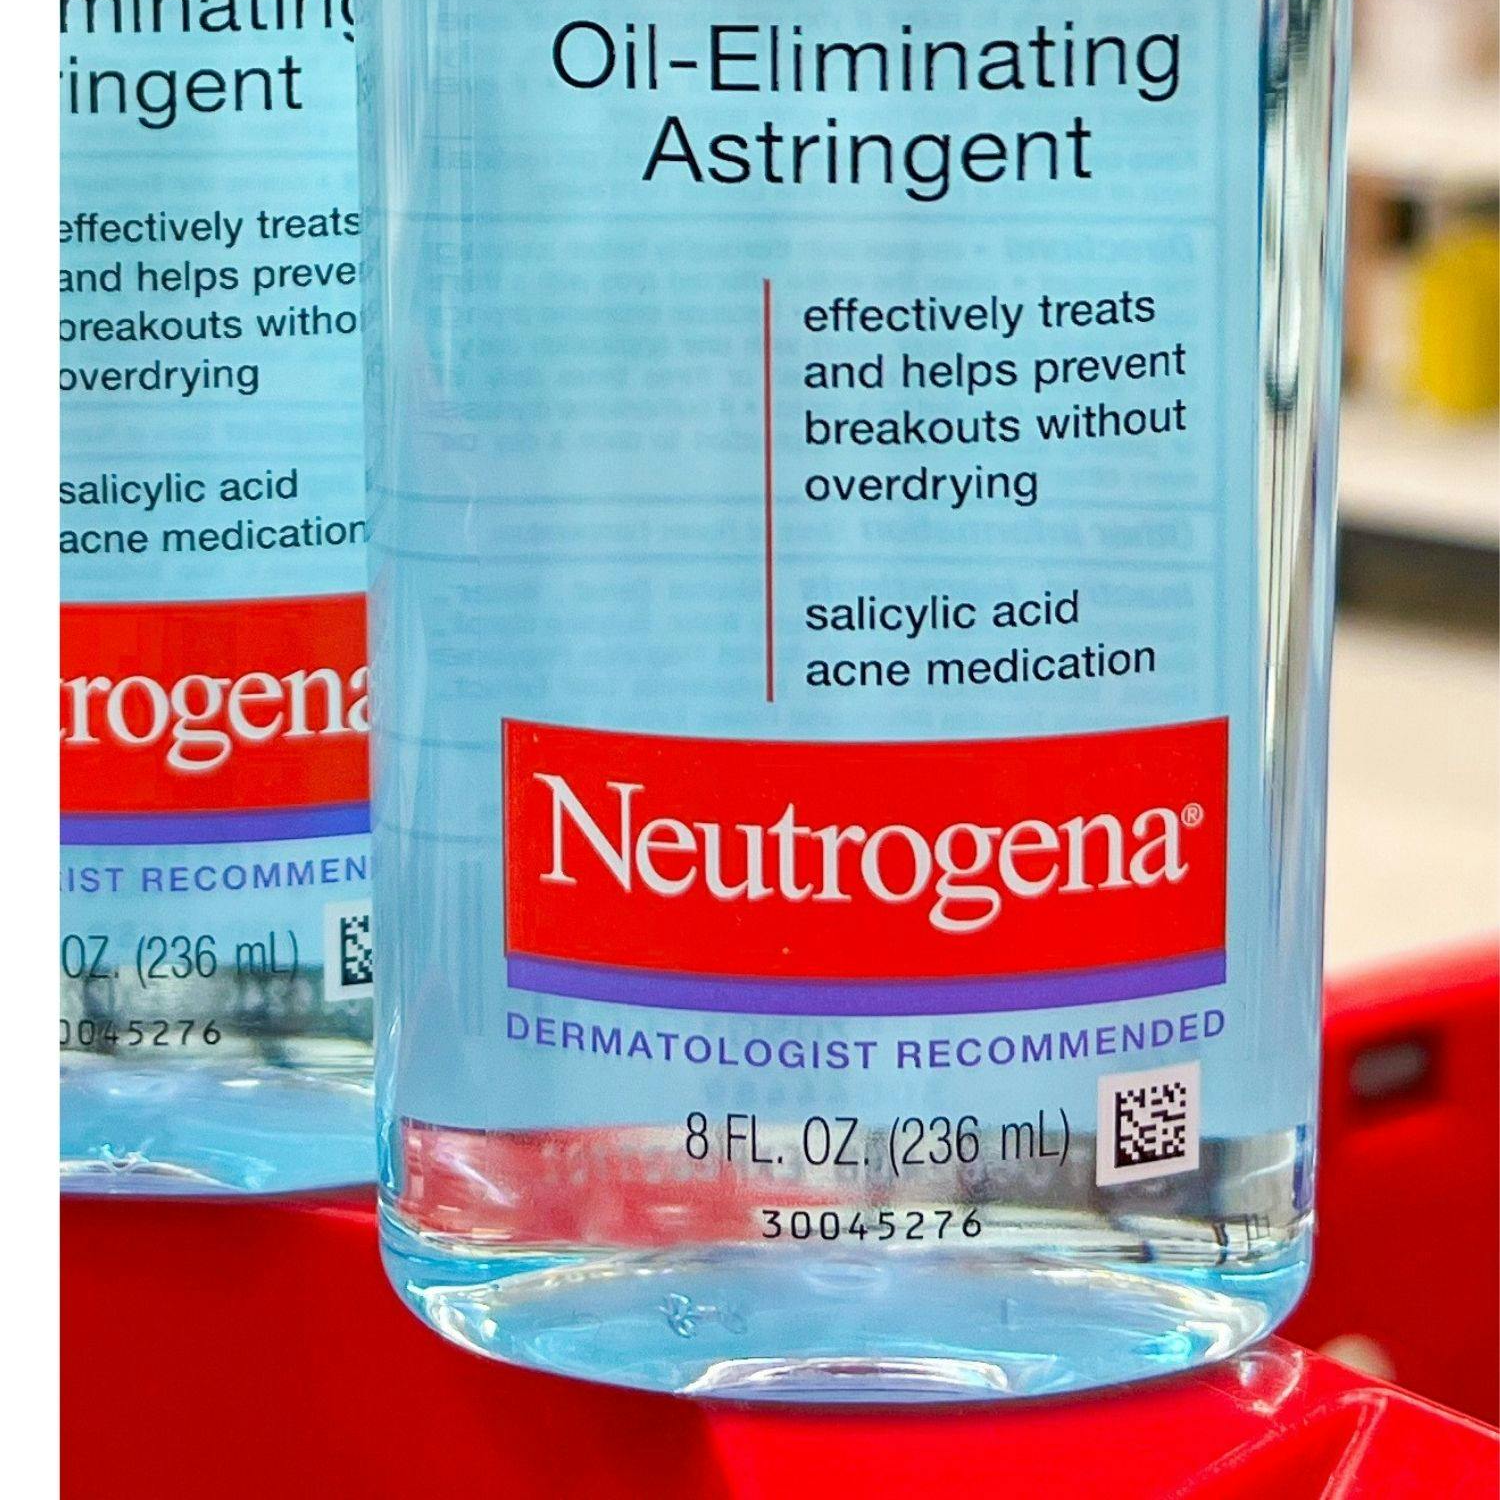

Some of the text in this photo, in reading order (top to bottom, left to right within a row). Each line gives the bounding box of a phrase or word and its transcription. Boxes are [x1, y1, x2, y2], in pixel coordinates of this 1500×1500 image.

[552, 20, 1180, 101] Oil-Eliminating
[60, 55, 302, 130] ingent
[642, 115, 1092, 201] Astringent
[60, 207, 361, 248] effectively treats
[60, 261, 121, 292] and
[138, 260, 239, 298] helps
[803, 290, 1156, 338] effectively treats
[60, 359, 259, 397] overdrying
[803, 343, 1187, 394] and helps prevent
[805, 399, 1187, 446] breakouts without
[60, 468, 298, 511] salicylic acid
[805, 465, 1039, 509] overdrying
[60, 516, 366, 553] acne medication
[806, 589, 1079, 639] salicylic acid
[806, 644, 1156, 687] acne medication
[60, 668, 370, 771] rogen
[60, 867, 124, 893] IST
[62, 930, 298, 988] OZ. (236 mL)
[507, 1008, 1225, 1070] DERMATOLOGIST RECOMMENDED
[685, 1111, 709, 1160] 8
[727, 1113, 784, 1164] FL.
[803, 1116, 870, 1168] OZ.
[888, 1113, 980, 1178] (236
[1001, 1107, 1071, 1168] mL)
[762, 1209, 982, 1240] 30045276
